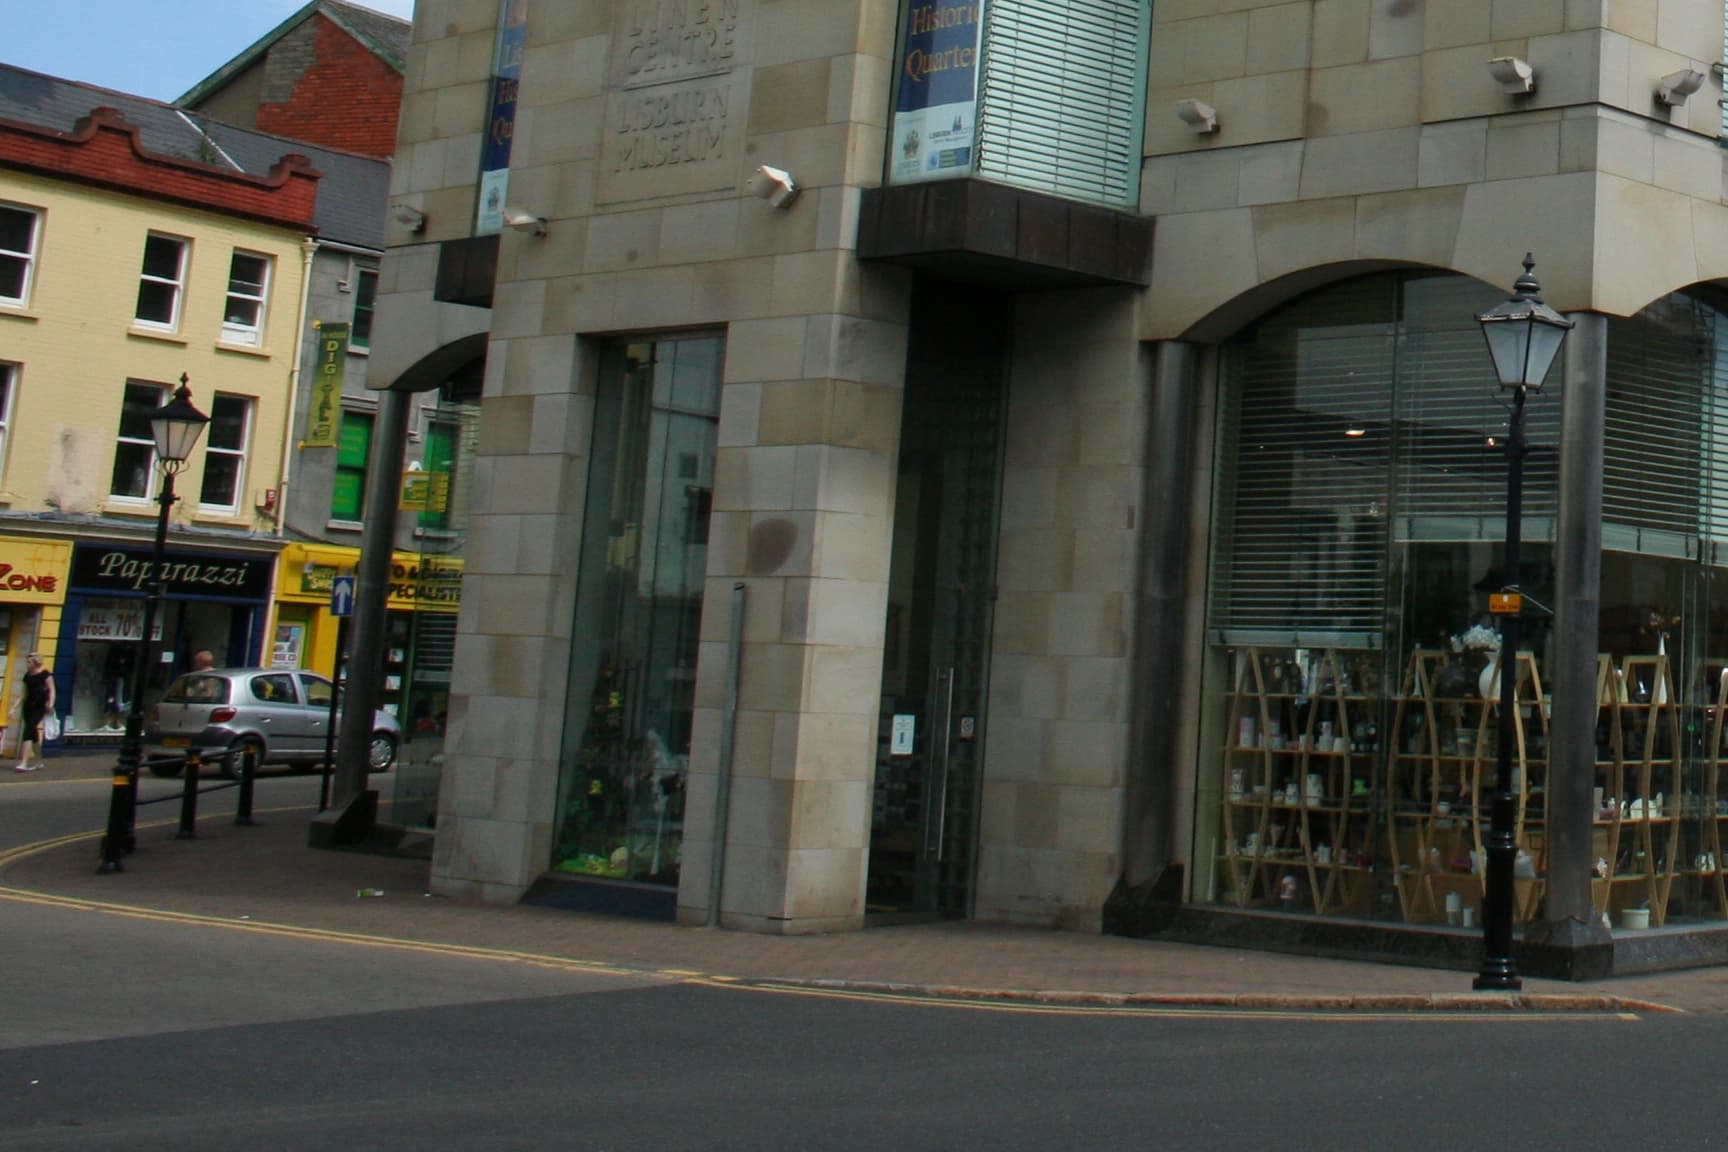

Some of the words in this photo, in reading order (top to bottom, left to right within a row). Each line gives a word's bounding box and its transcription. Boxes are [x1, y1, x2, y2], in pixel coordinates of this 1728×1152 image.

[628, 25, 736, 75] CENTRE
[617, 84, 731, 134] LISBURN
[614, 124, 727, 174] MUSEUM
